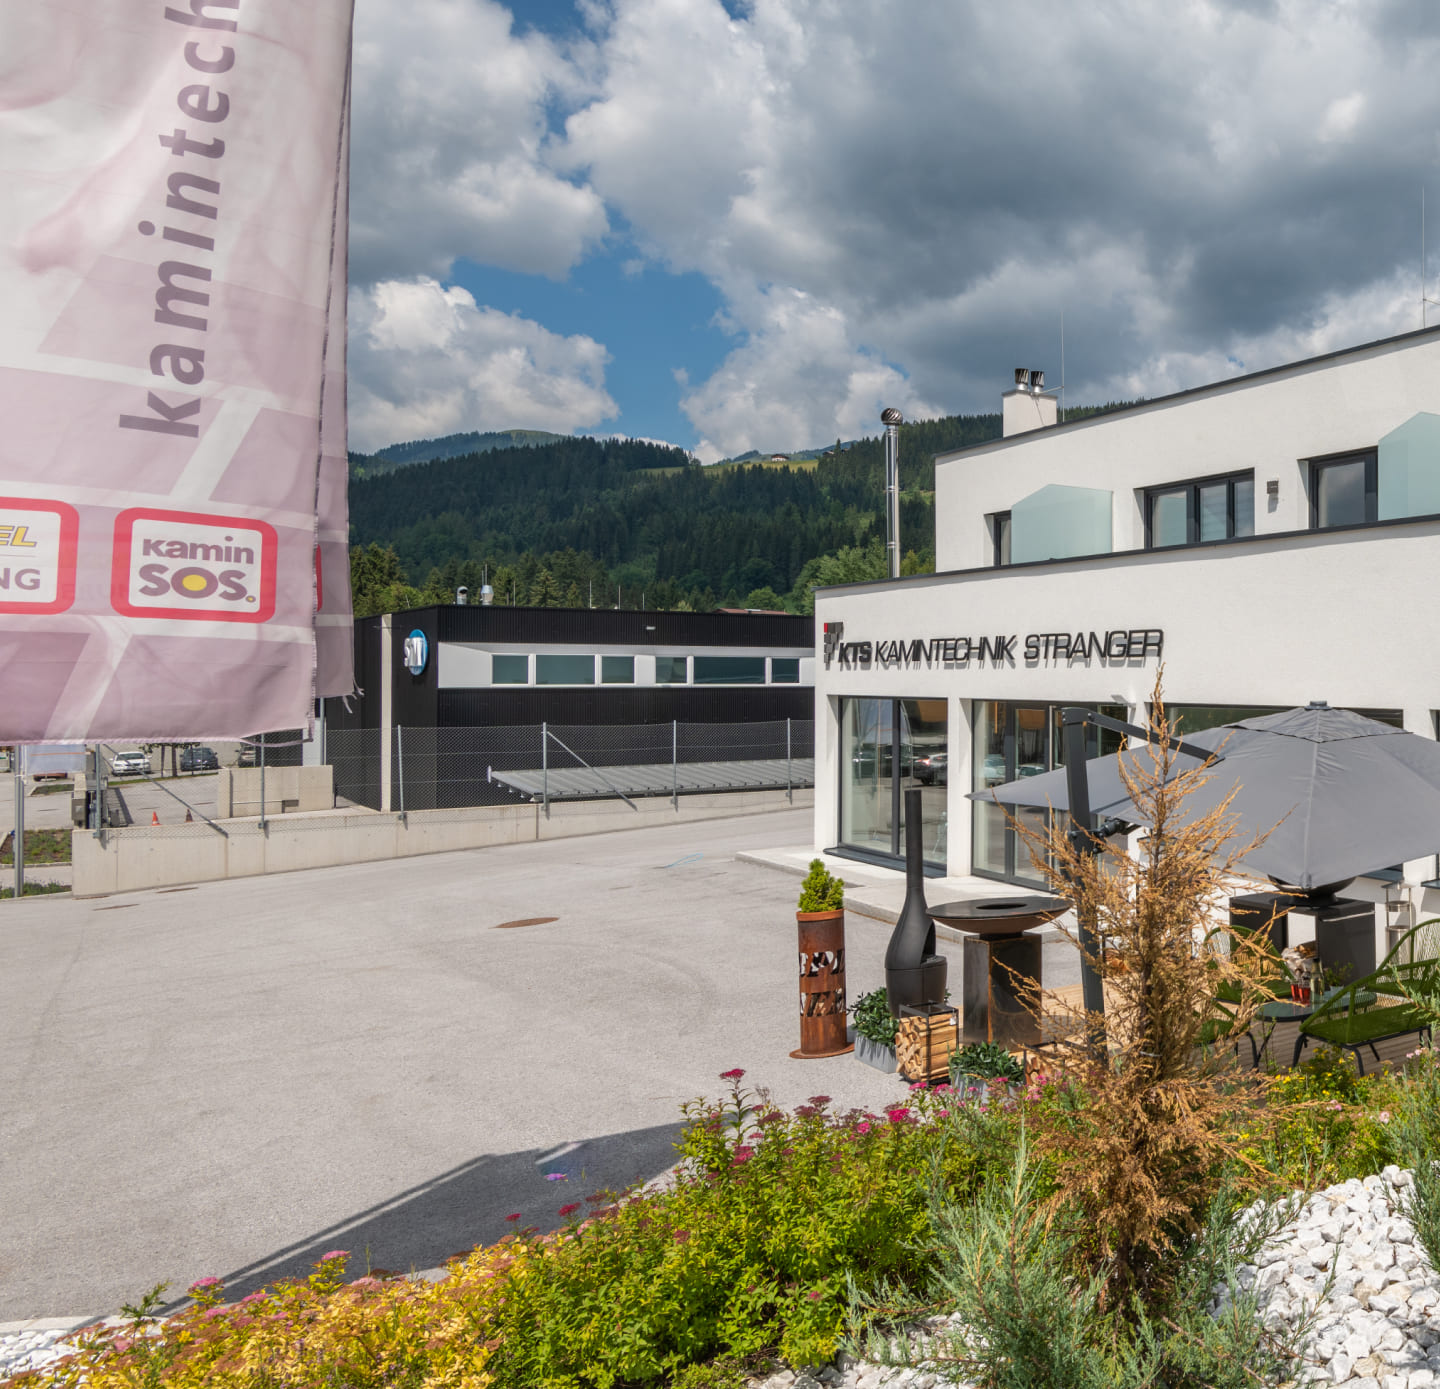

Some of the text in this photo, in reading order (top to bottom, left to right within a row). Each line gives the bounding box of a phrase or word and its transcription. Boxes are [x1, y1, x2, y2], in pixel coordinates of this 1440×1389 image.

[118, 0, 240, 438] kamintech
[142, 535, 254, 565] kamin
[838, 629, 1164, 663] KTS KAMINTECHNIK STRANGER
